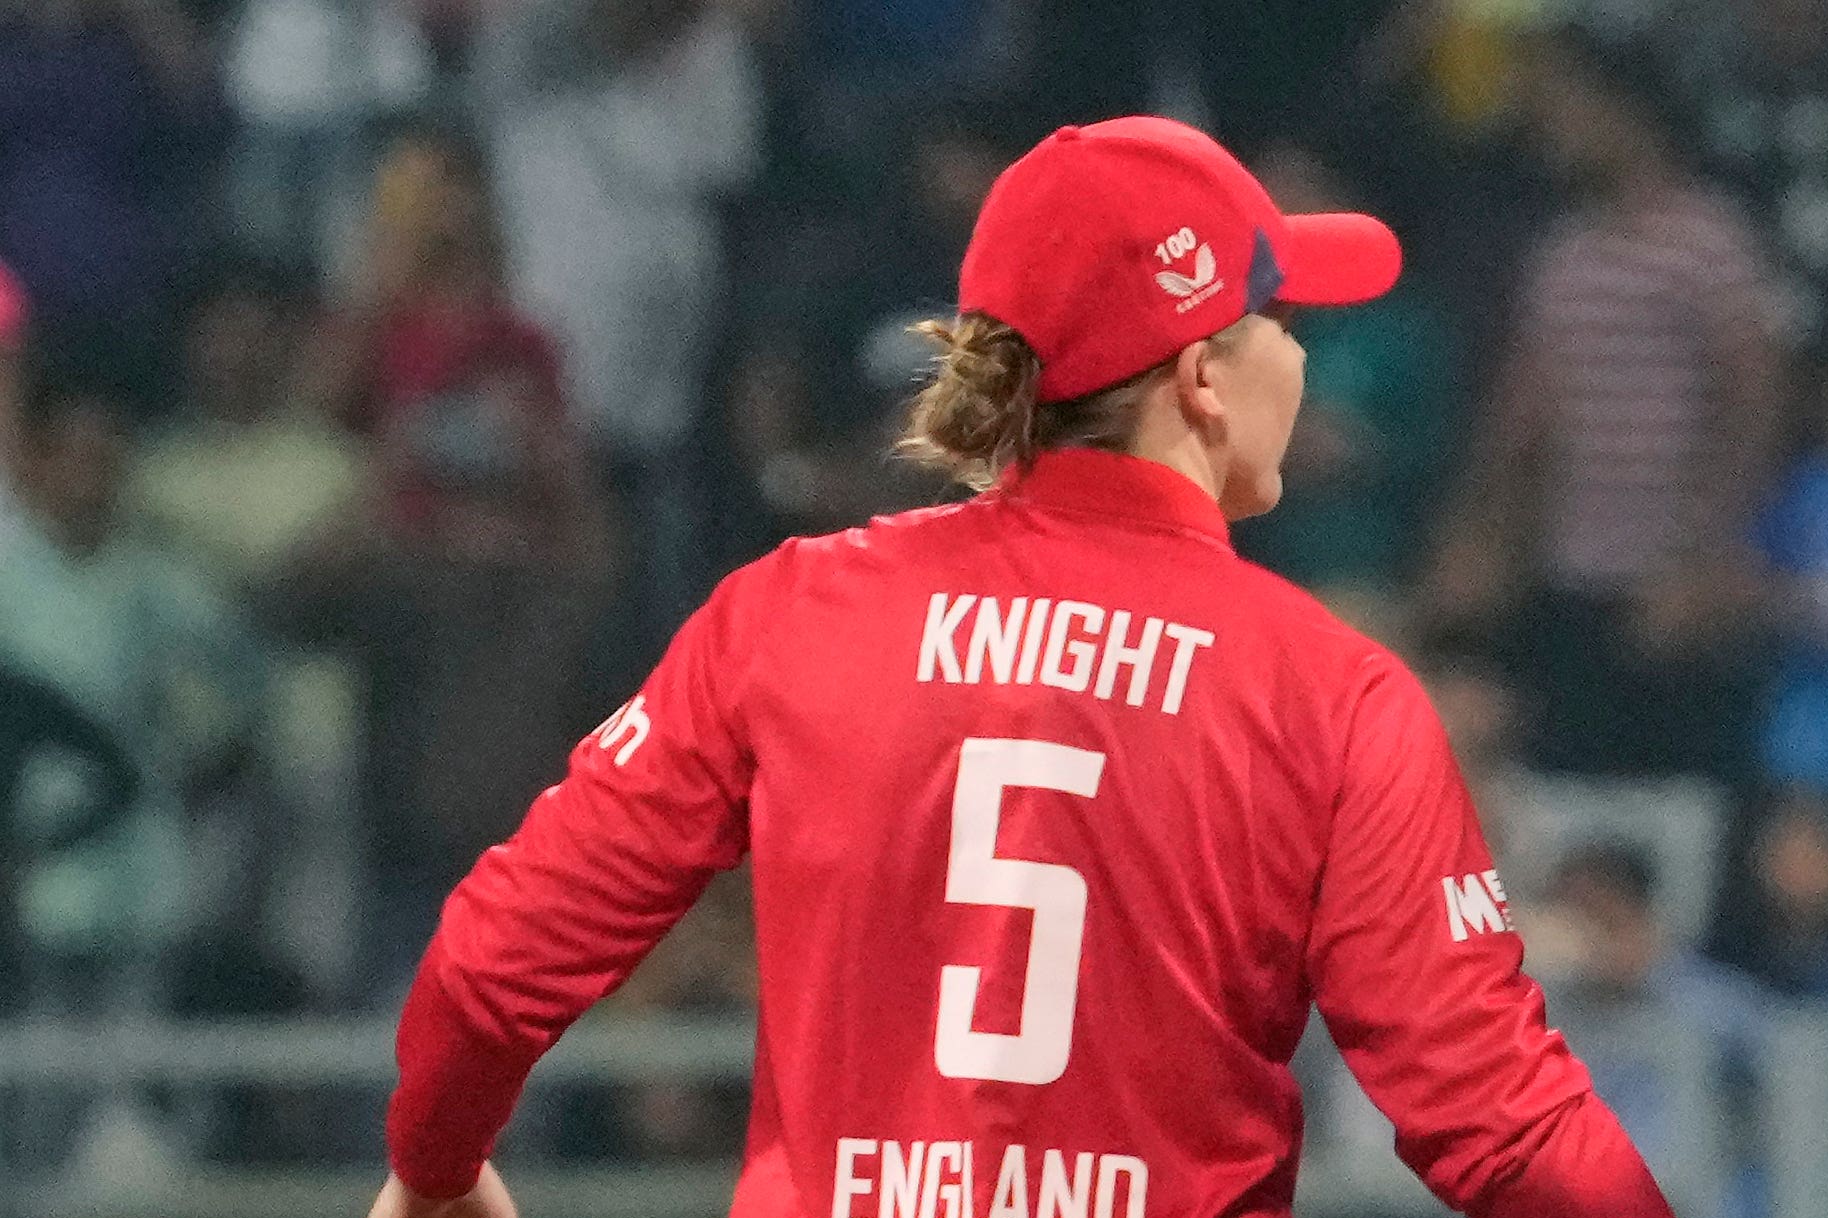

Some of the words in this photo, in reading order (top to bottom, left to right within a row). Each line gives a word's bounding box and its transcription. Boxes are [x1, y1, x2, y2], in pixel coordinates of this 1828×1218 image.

[1154, 227, 1197, 266] 100
[917, 592, 1215, 715] KNIGHT
[934, 737, 1106, 1085] 5
